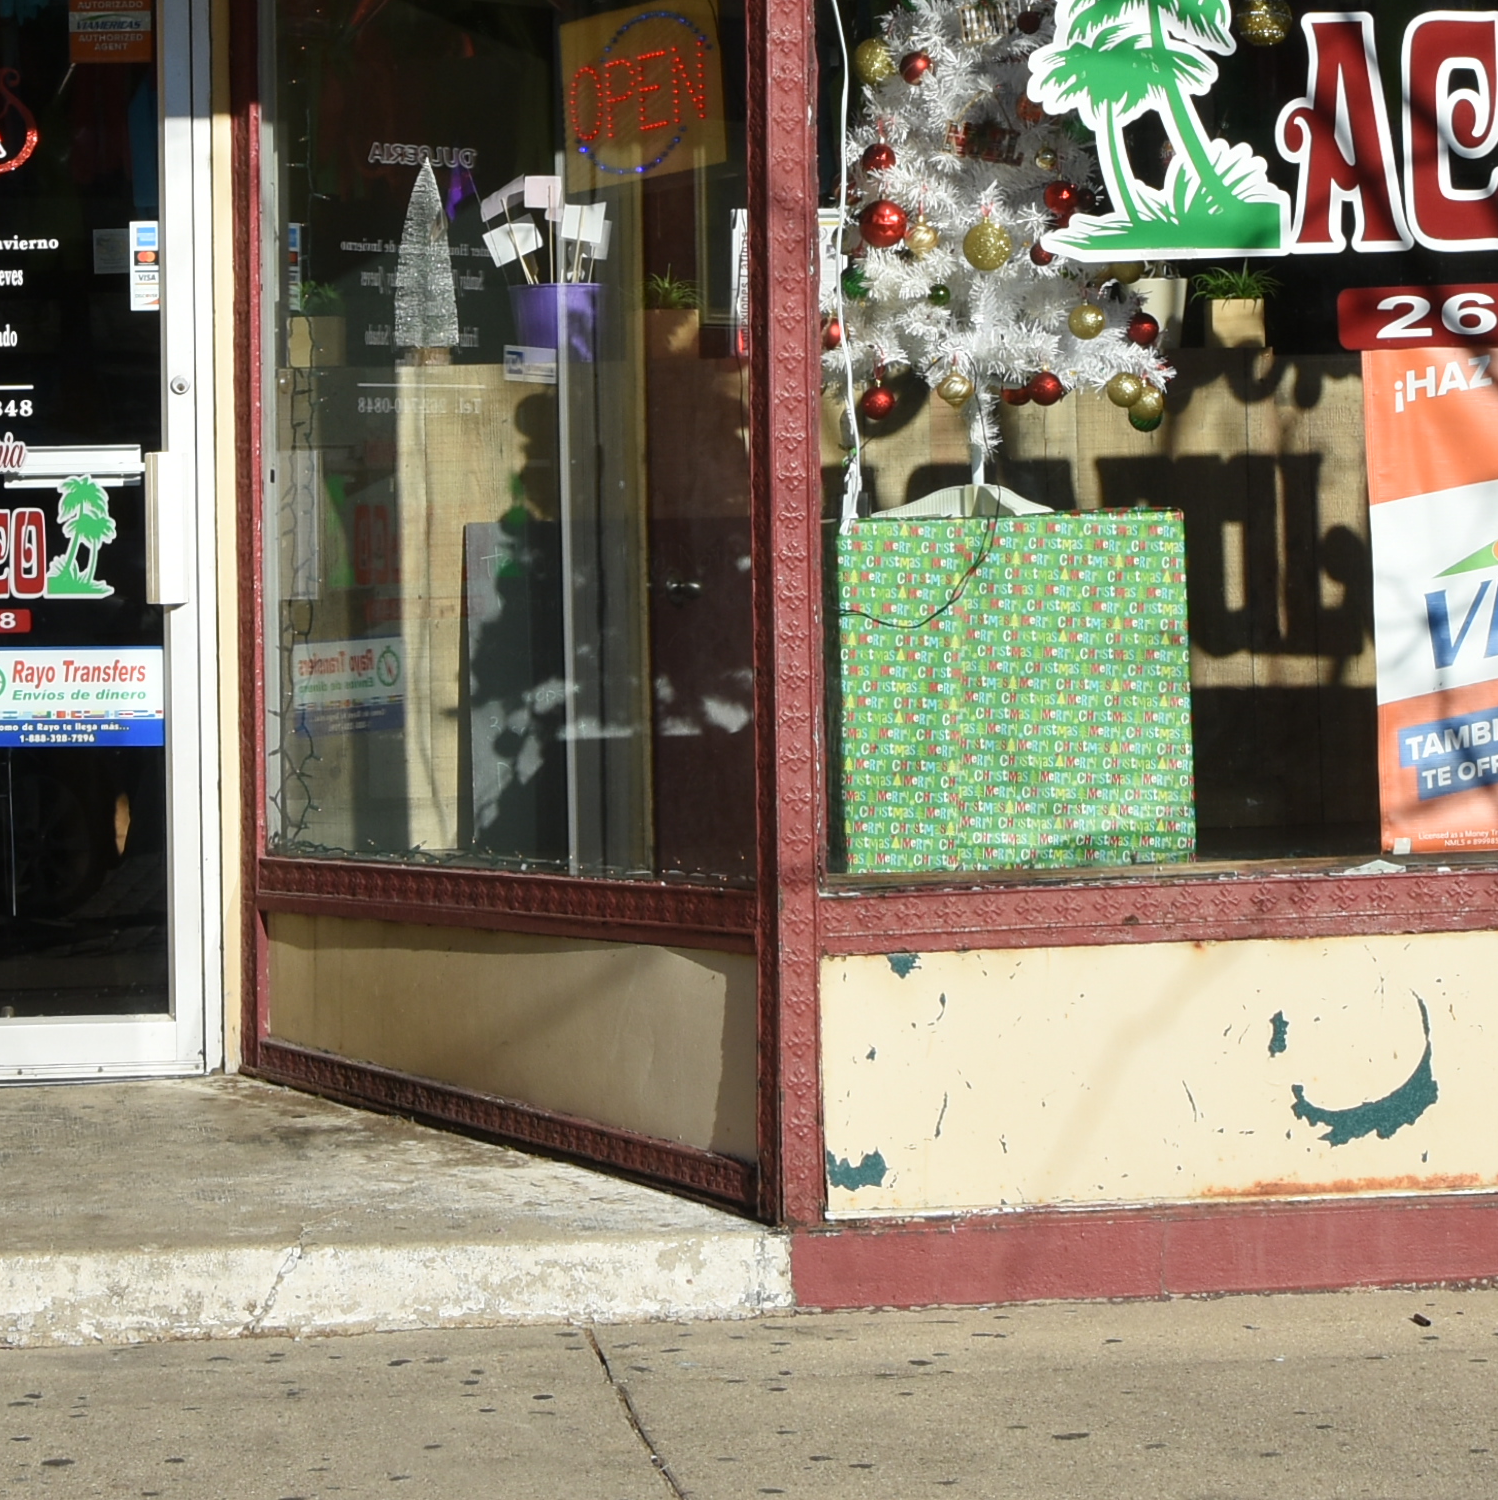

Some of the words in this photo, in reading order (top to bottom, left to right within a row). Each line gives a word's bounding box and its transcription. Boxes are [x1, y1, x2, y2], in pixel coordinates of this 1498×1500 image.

[77, 1, 143, 9] AUTORIZADO
[77, 21, 141, 30] VIAMERICAS
[78, 33, 143, 42] AUTHORIZED
[94, 43, 128, 51] AGENT
[569, 39, 707, 141] OPEN
[12, 660, 56, 689] Rayo
[62, 659, 147, 683] Transfers
[12, 688, 65, 701] Envíos
[70, 688, 90, 700] de
[96, 688, 147, 700] dinero
[21, 722, 34, 731] de
[36, 722, 60, 733] Rayo
[62, 723, 72, 731] te
[75, 722, 98, 733] llega
[19, 734, 95, 743] 1-888-328-7296
[1422, 767, 1452, 790] TE
